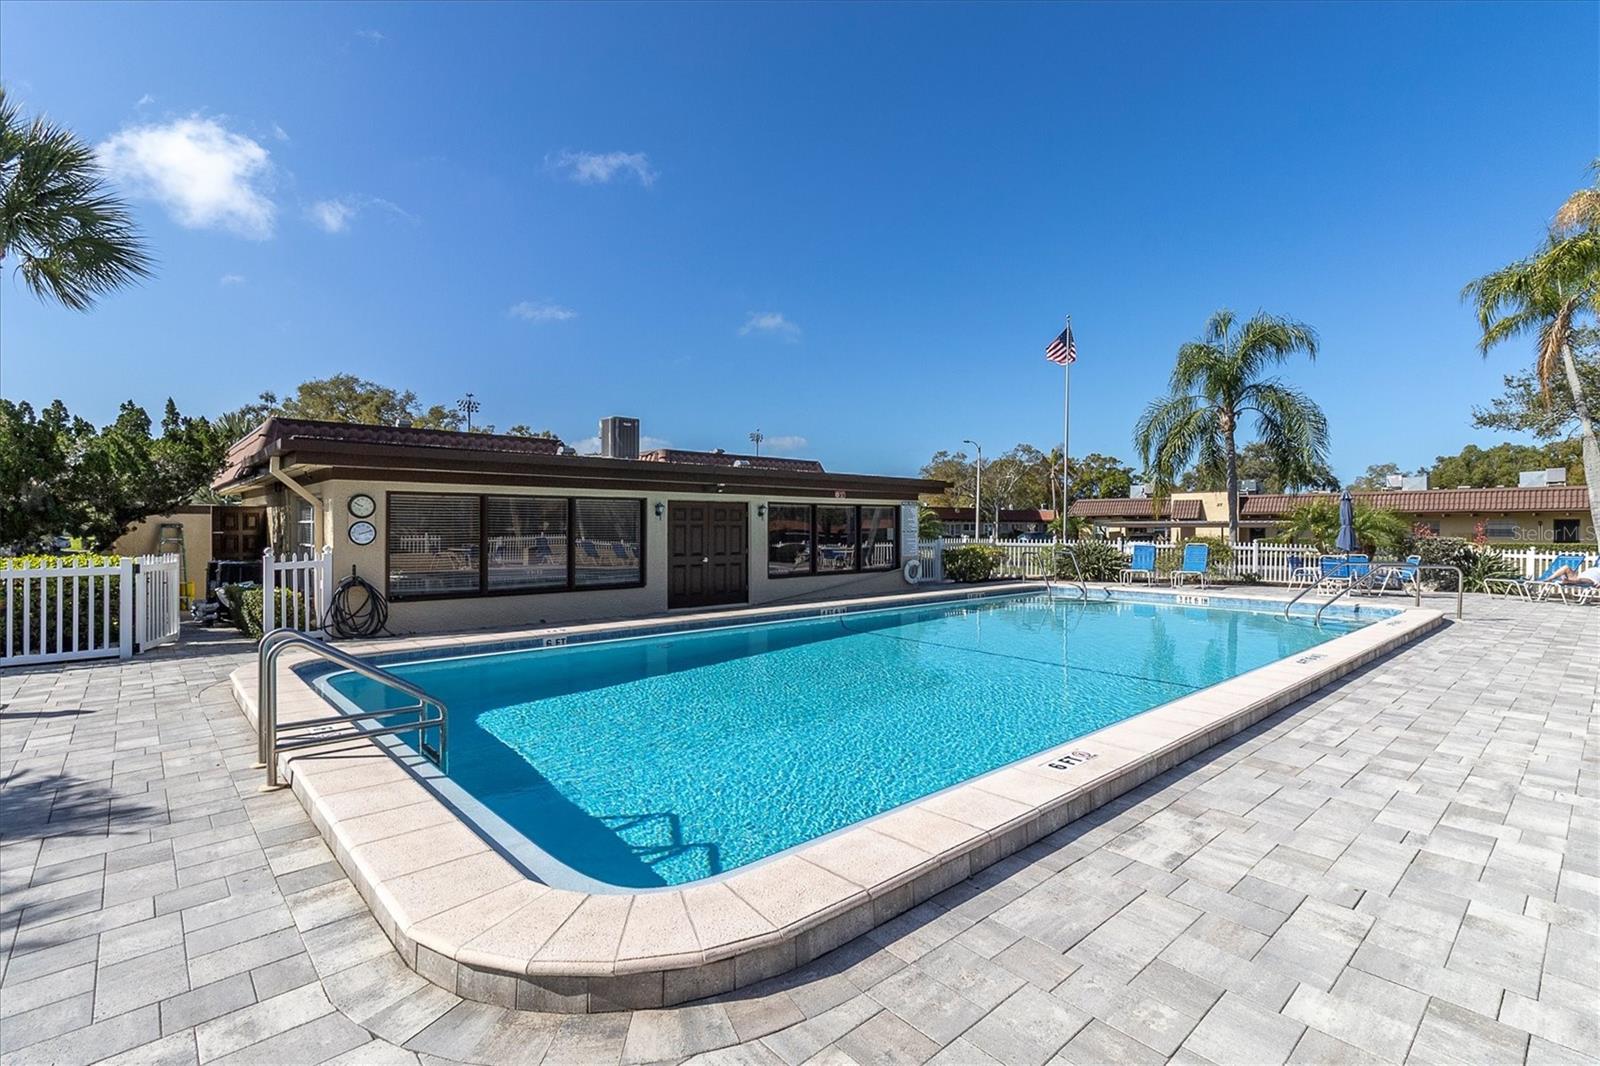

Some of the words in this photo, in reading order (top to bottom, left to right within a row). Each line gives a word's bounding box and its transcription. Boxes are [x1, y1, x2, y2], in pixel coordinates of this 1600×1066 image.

[546, 639, 552, 647] 6
[555, 637, 566, 646] FT
[1048, 762, 1068, 770] 6
[1058, 755, 1083, 766] FT
